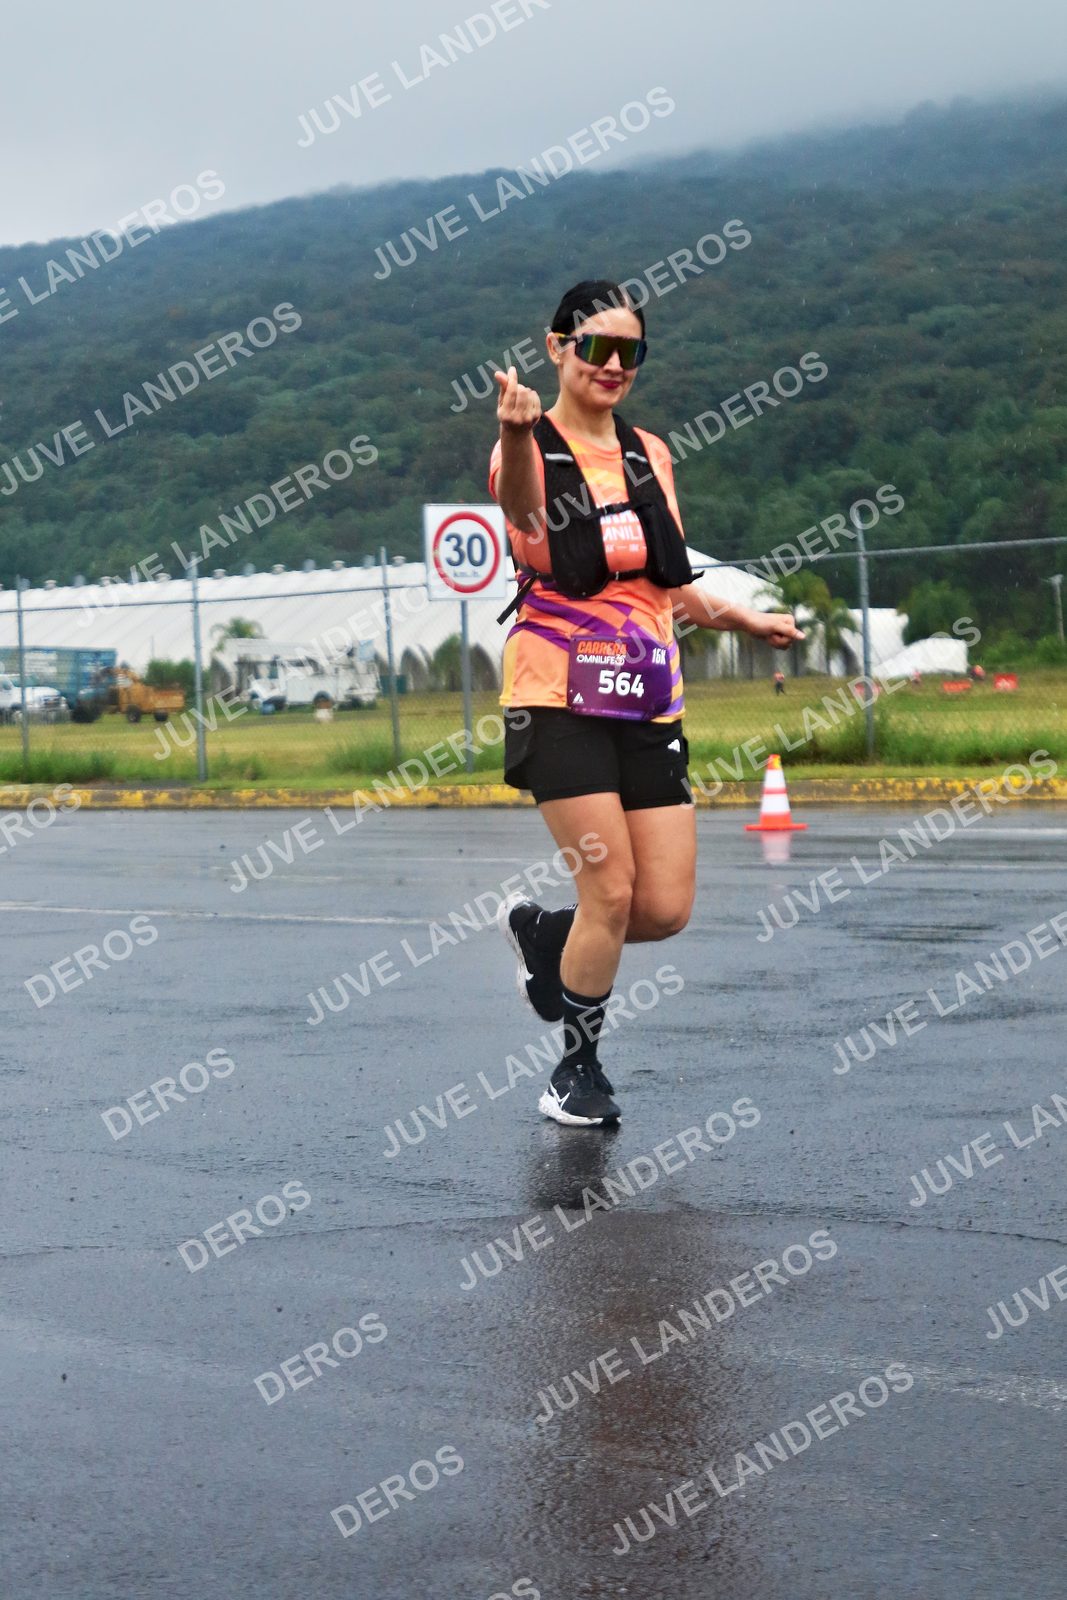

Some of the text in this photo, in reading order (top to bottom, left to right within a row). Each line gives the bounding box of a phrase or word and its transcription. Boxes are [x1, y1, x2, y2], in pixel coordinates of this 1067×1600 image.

[444, 532, 487, 567] 30
[577, 640, 627, 655] CARRERA
[598, 669, 645, 698] 564
